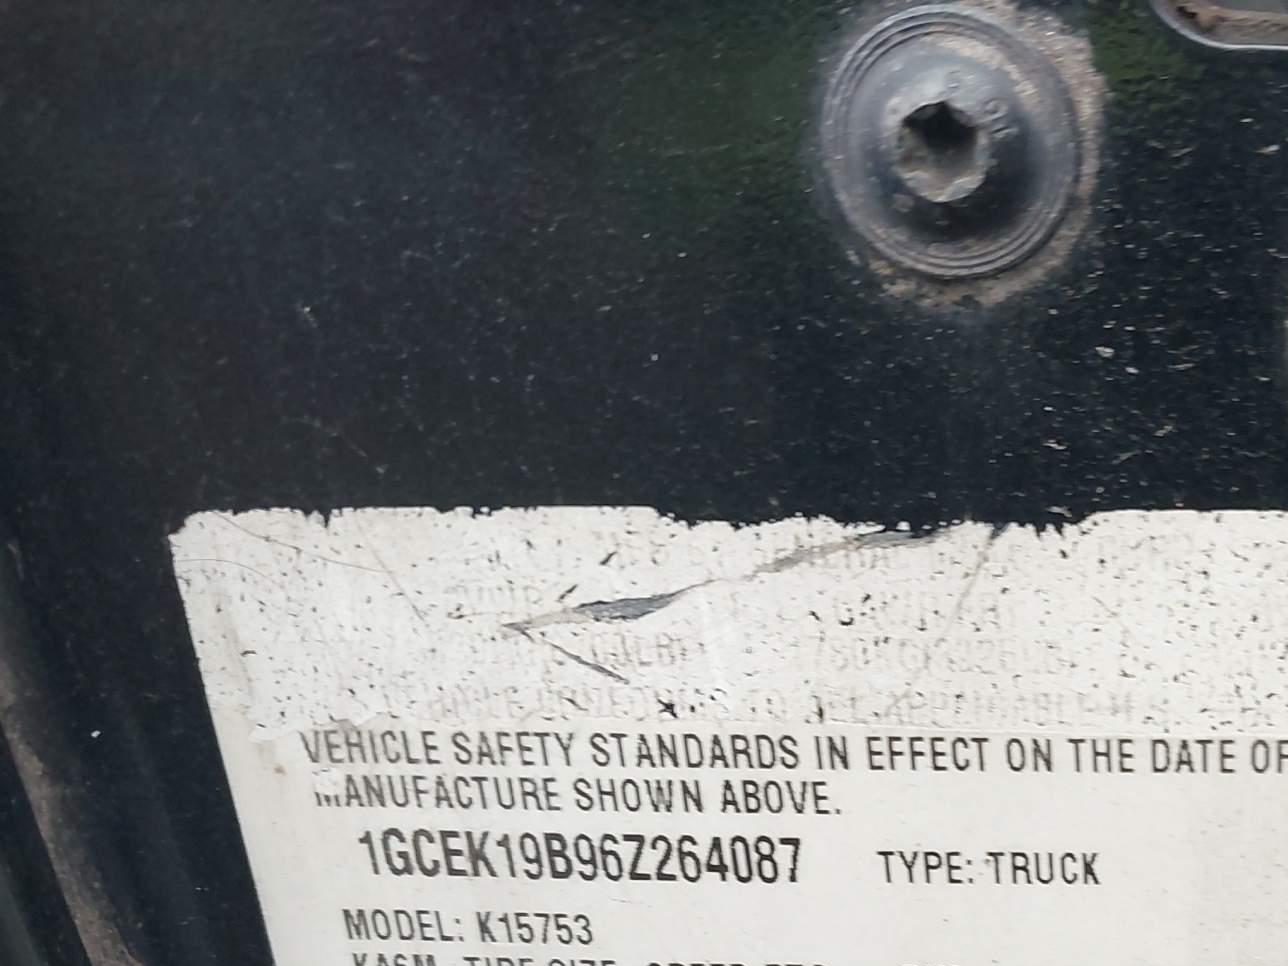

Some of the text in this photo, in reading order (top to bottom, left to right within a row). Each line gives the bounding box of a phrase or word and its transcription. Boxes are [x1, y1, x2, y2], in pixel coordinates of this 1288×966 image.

[300, 729, 441, 765] VEHICLE
[451, 730, 574, 767] SAFETY
[589, 732, 800, 770] STANDARDS
[814, 735, 850, 771] IN
[866, 735, 990, 772] EFFECT
[1006, 738, 1052, 773] ON
[1067, 738, 1136, 774] THE
[1151, 738, 1236, 774] DATE
[573, 778, 705, 814] SHOWN
[721, 779, 842, 815] ABOVE.
[358, 828, 1102, 886] 1GCEK19B96Z264087 TYPE: TRUCK
[342, 908, 594, 946] MODEL: K15753
